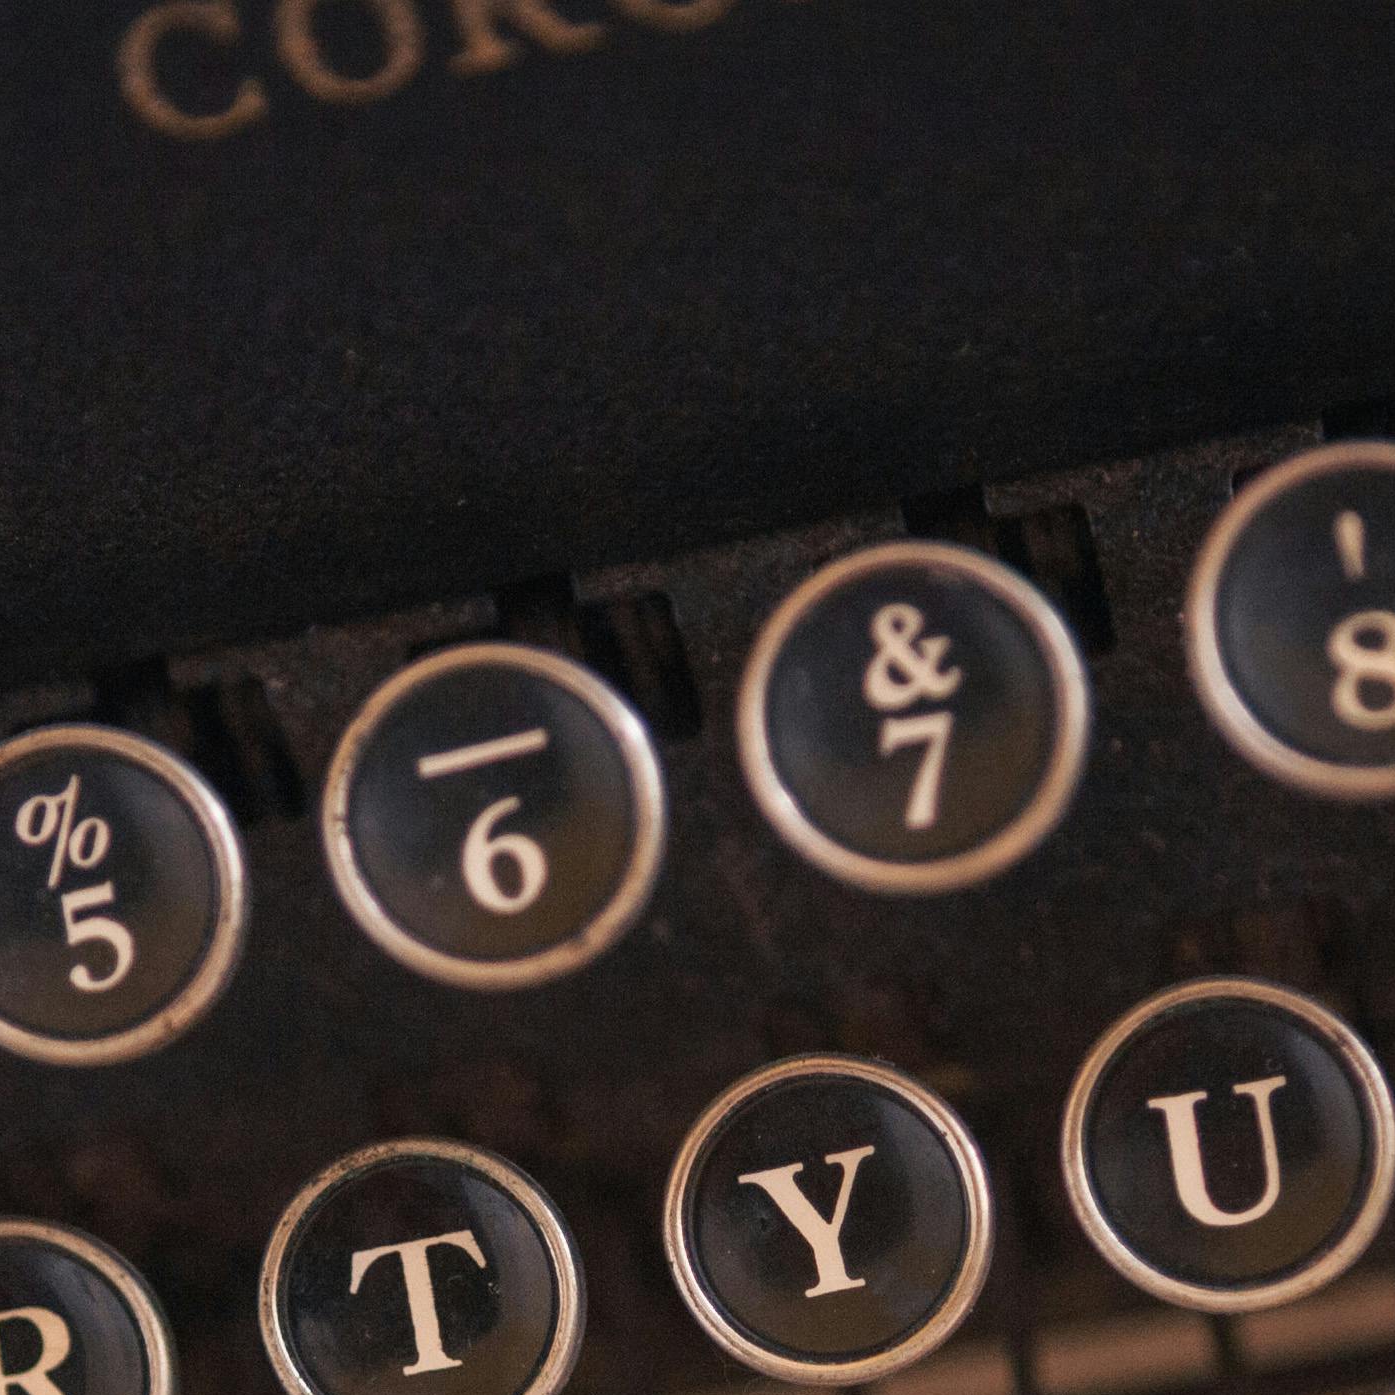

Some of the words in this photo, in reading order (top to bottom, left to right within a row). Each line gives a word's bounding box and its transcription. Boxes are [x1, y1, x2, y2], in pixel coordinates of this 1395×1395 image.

[115, 0, 733, 141] COR
[866, 605, 958, 708] &
[882, 713, 951, 828] 7
[16, 777, 109, 886] %
[463, 798, 546, 913] 6
[62, 883, 134, 991] 5
[1148, 1076, 1286, 1227] U
[738, 1145, 875, 1298] Y
[349, 1229, 486, 1376] T
